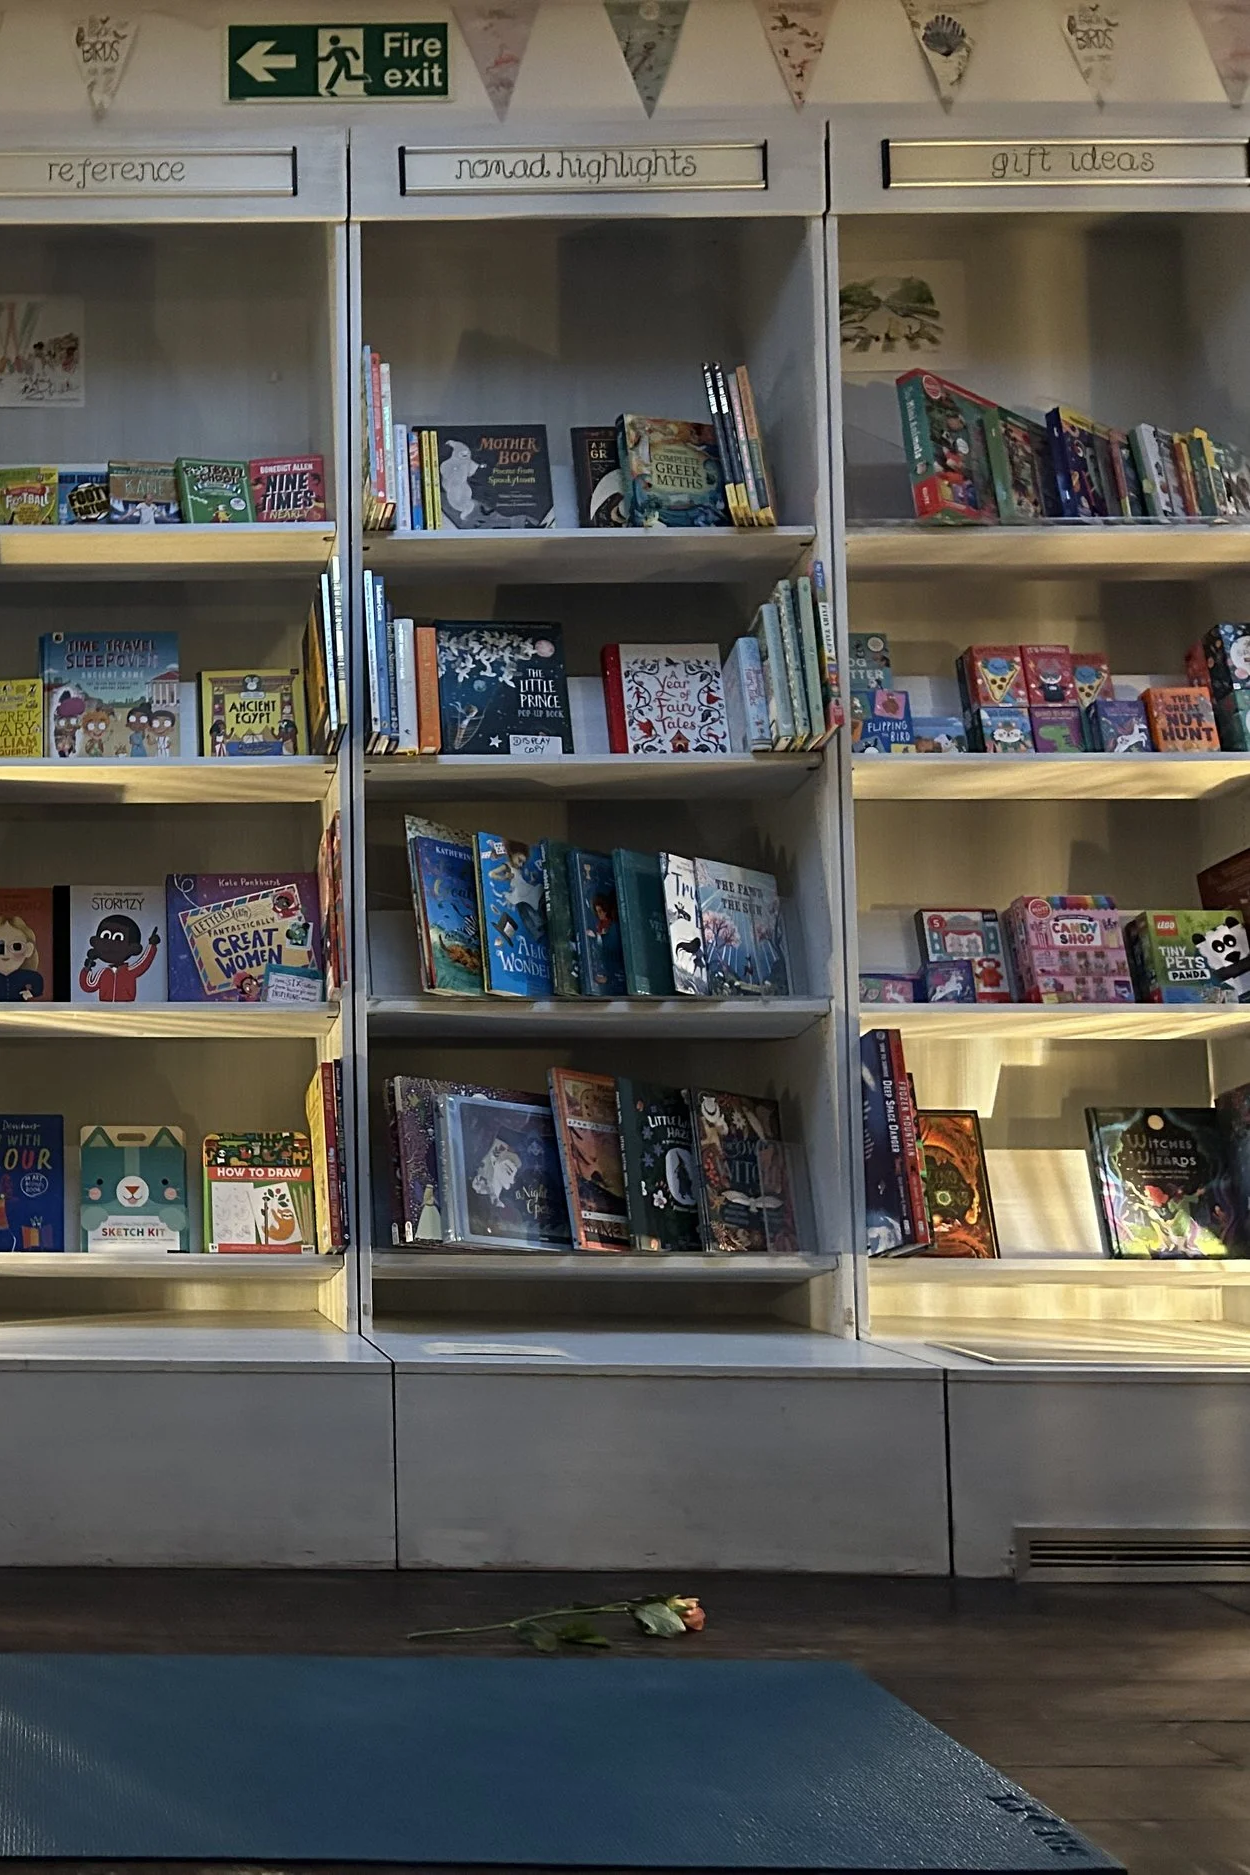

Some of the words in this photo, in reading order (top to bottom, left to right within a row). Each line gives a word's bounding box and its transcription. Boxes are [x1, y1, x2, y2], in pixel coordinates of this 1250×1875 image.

[384, 31, 442, 59] Fire
[384, 62, 443, 88] exit
[455, 153, 551, 180] nomad
[557, 148, 697, 184] highlights
[991, 146, 1051, 178] gift
[1070, 145, 1154, 173] ideas
[47, 157, 186, 189] reference
[478, 436, 541, 452] MOTHER
[498, 449, 533, 466] BOO
[260, 465, 291, 474] BENEDICT
[293, 463, 314, 471] ALLEN
[655, 464, 702, 478] GREEK
[266, 473, 310, 493] NINE
[656, 474, 704, 489] MYTHS
[124, 480, 165, 498] KANE
[5, 486, 50, 509] FOOTBALL
[262, 490, 316, 512] TIMES
[270, 509, 310, 519] NEARLY
[66, 639, 99, 654] TIME
[104, 638, 156, 653] TRAVEL
[65, 655, 158, 669] SLEEPOVER
[525, 669, 543, 678] THE
[669, 670, 679, 680] A
[519, 678, 557, 693] LITTLE
[653, 675, 690, 697] Year
[519, 694, 561, 709] PRINCE
[679, 688, 692, 701] of
[1171, 695, 1190, 704] THE
[228, 700, 277, 713] ANCIENT
[654, 697, 697, 718] Fairy
[1165, 703, 1200, 713] GREAT
[236, 712, 271, 725] EGYPT
[654, 716, 697, 734] Tales
[1166, 713, 1204, 726] NUT
[867, 721, 908, 733] FLIPPING
[891, 731, 911, 742] BIRD
[1161, 728, 1213, 742] HUNT
[512, 737, 551, 748] DISPLAY
[524, 745, 544, 755] COPY
[219, 878, 237, 887] Kate
[240, 877, 280, 887] Pankhurst
[715, 879, 735, 893] THE
[92, 897, 145, 911] STORMZY
[721, 898, 741, 912] THE
[193, 908, 231, 934] LETTERS
[208, 916, 276, 938] FANTASTICALLY
[1052, 921, 1098, 934] CANDY
[1157, 921, 1175, 930] LEGO
[212, 928, 279, 957] GREAT
[1060, 933, 1095, 945] SHOP
[518, 935, 550, 962] ALIC
[1158, 946, 1186, 957] TINY
[215, 944, 282, 979] WOMEN
[496, 950, 551, 980] WONDE
[1165, 956, 1206, 970] PETS
[1172, 970, 1208, 981] PANDA
[882, 1080, 893, 1098] DEEP
[898, 1081, 910, 1114] FROZEN
[885, 1100, 897, 1123] SPACE
[7, 1134, 41, 1147] WITH
[888, 1125, 900, 1153] DANGER
[902, 1115, 915, 1158] MOUNTAIN
[217, 1167, 246, 1178] HOW
[249, 1168, 265, 1177] TO
[267, 1167, 302, 1178] DRAW
[101, 1227, 145, 1237] SKETCH
[148, 1227, 166, 1237] KIT
